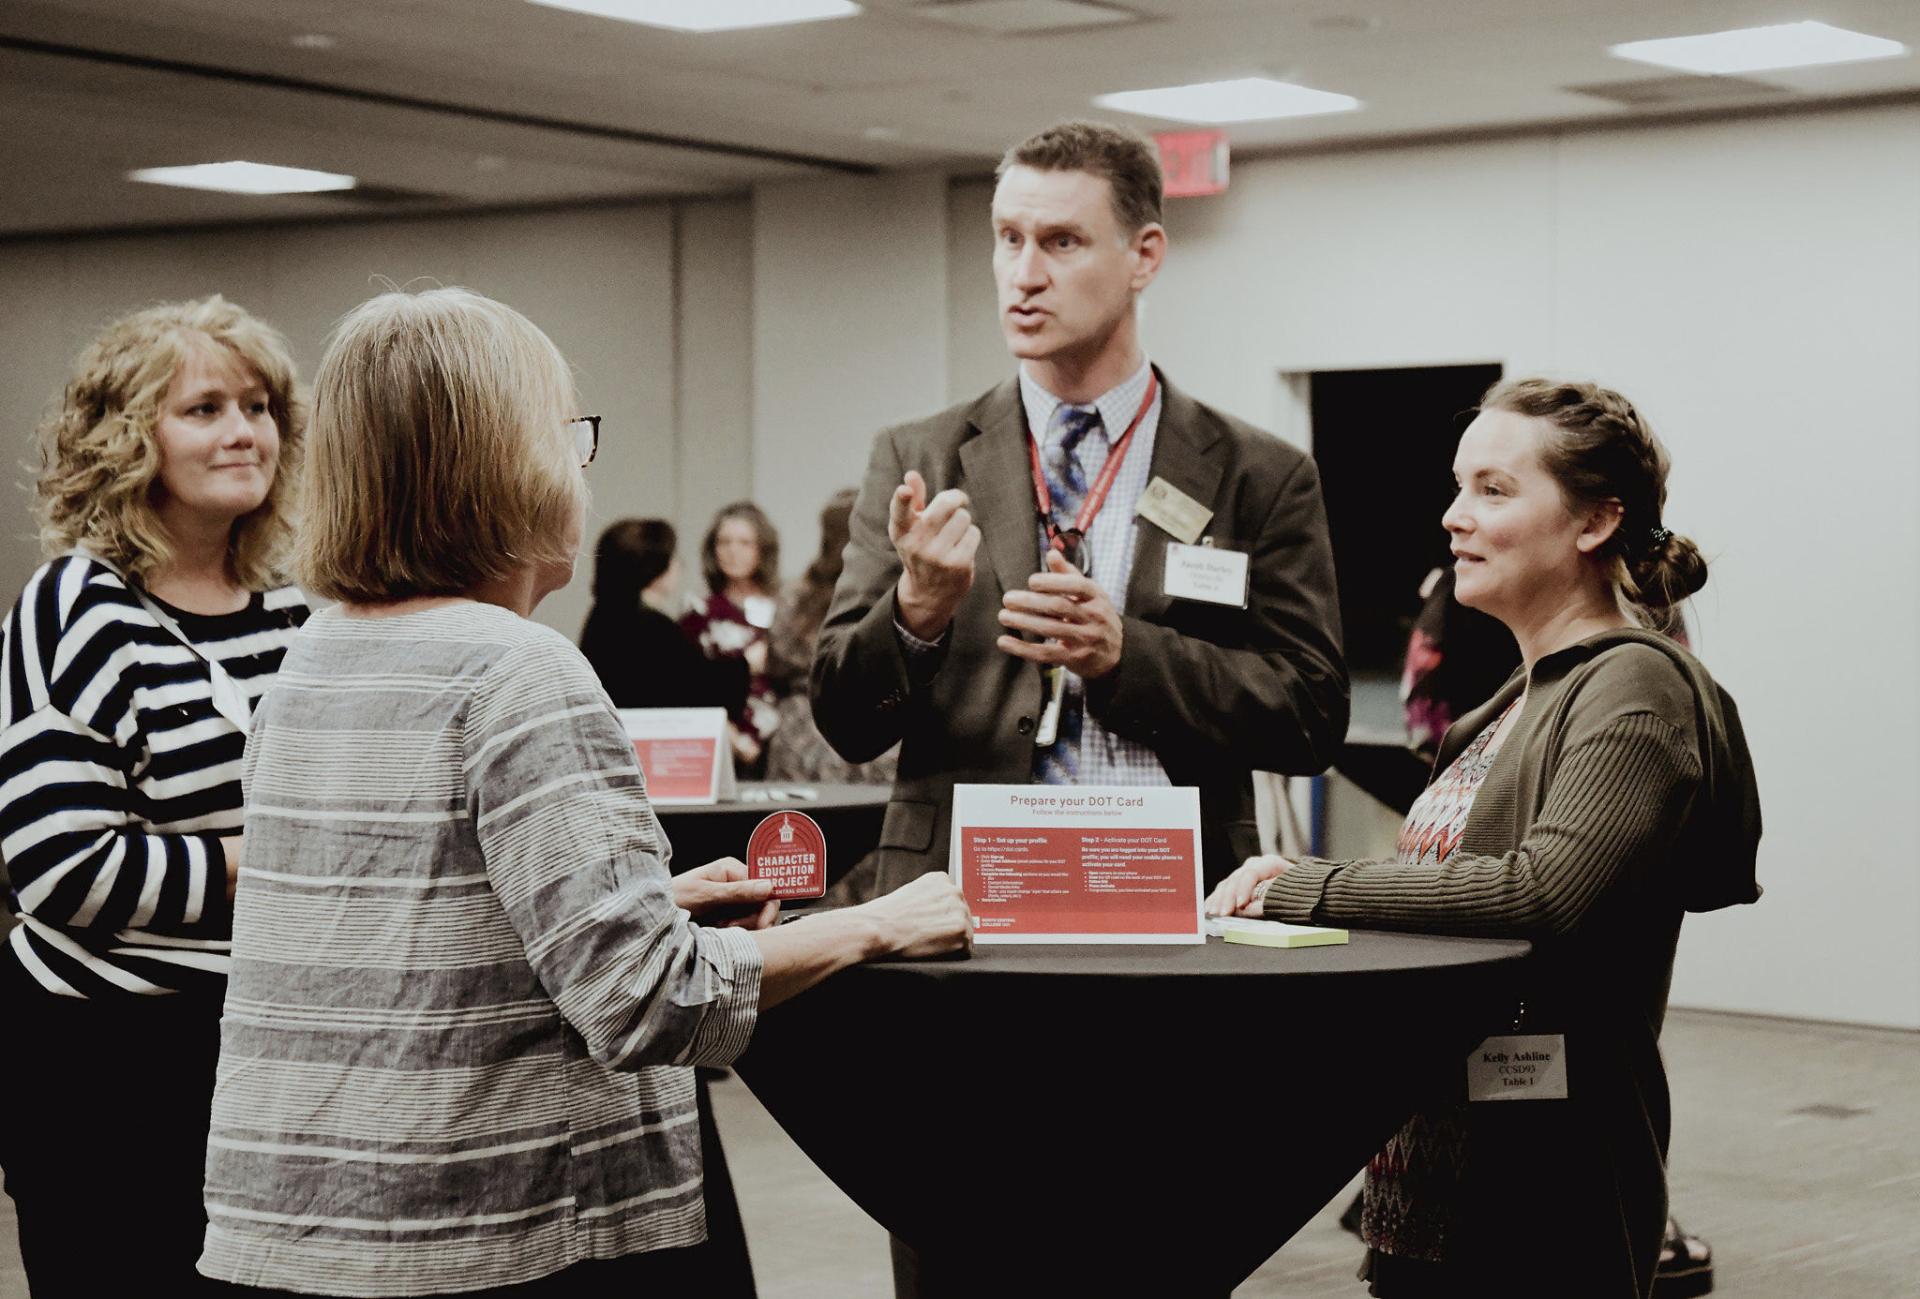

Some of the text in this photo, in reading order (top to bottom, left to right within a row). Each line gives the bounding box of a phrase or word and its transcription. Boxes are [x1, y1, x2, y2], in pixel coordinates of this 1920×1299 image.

[1010, 795, 1144, 808] Prepare your DOT Card
[973, 837, 987, 845] Step
[757, 853, 815, 866] CHARACTER
[759, 865, 814, 877] EDUCATION
[772, 876, 809, 887] ROJECT
[1483, 1051, 1551, 1064] Kelly Ashline
[1499, 1064, 1536, 1074] CCSD93
[1502, 1078, 1526, 1086] Table
